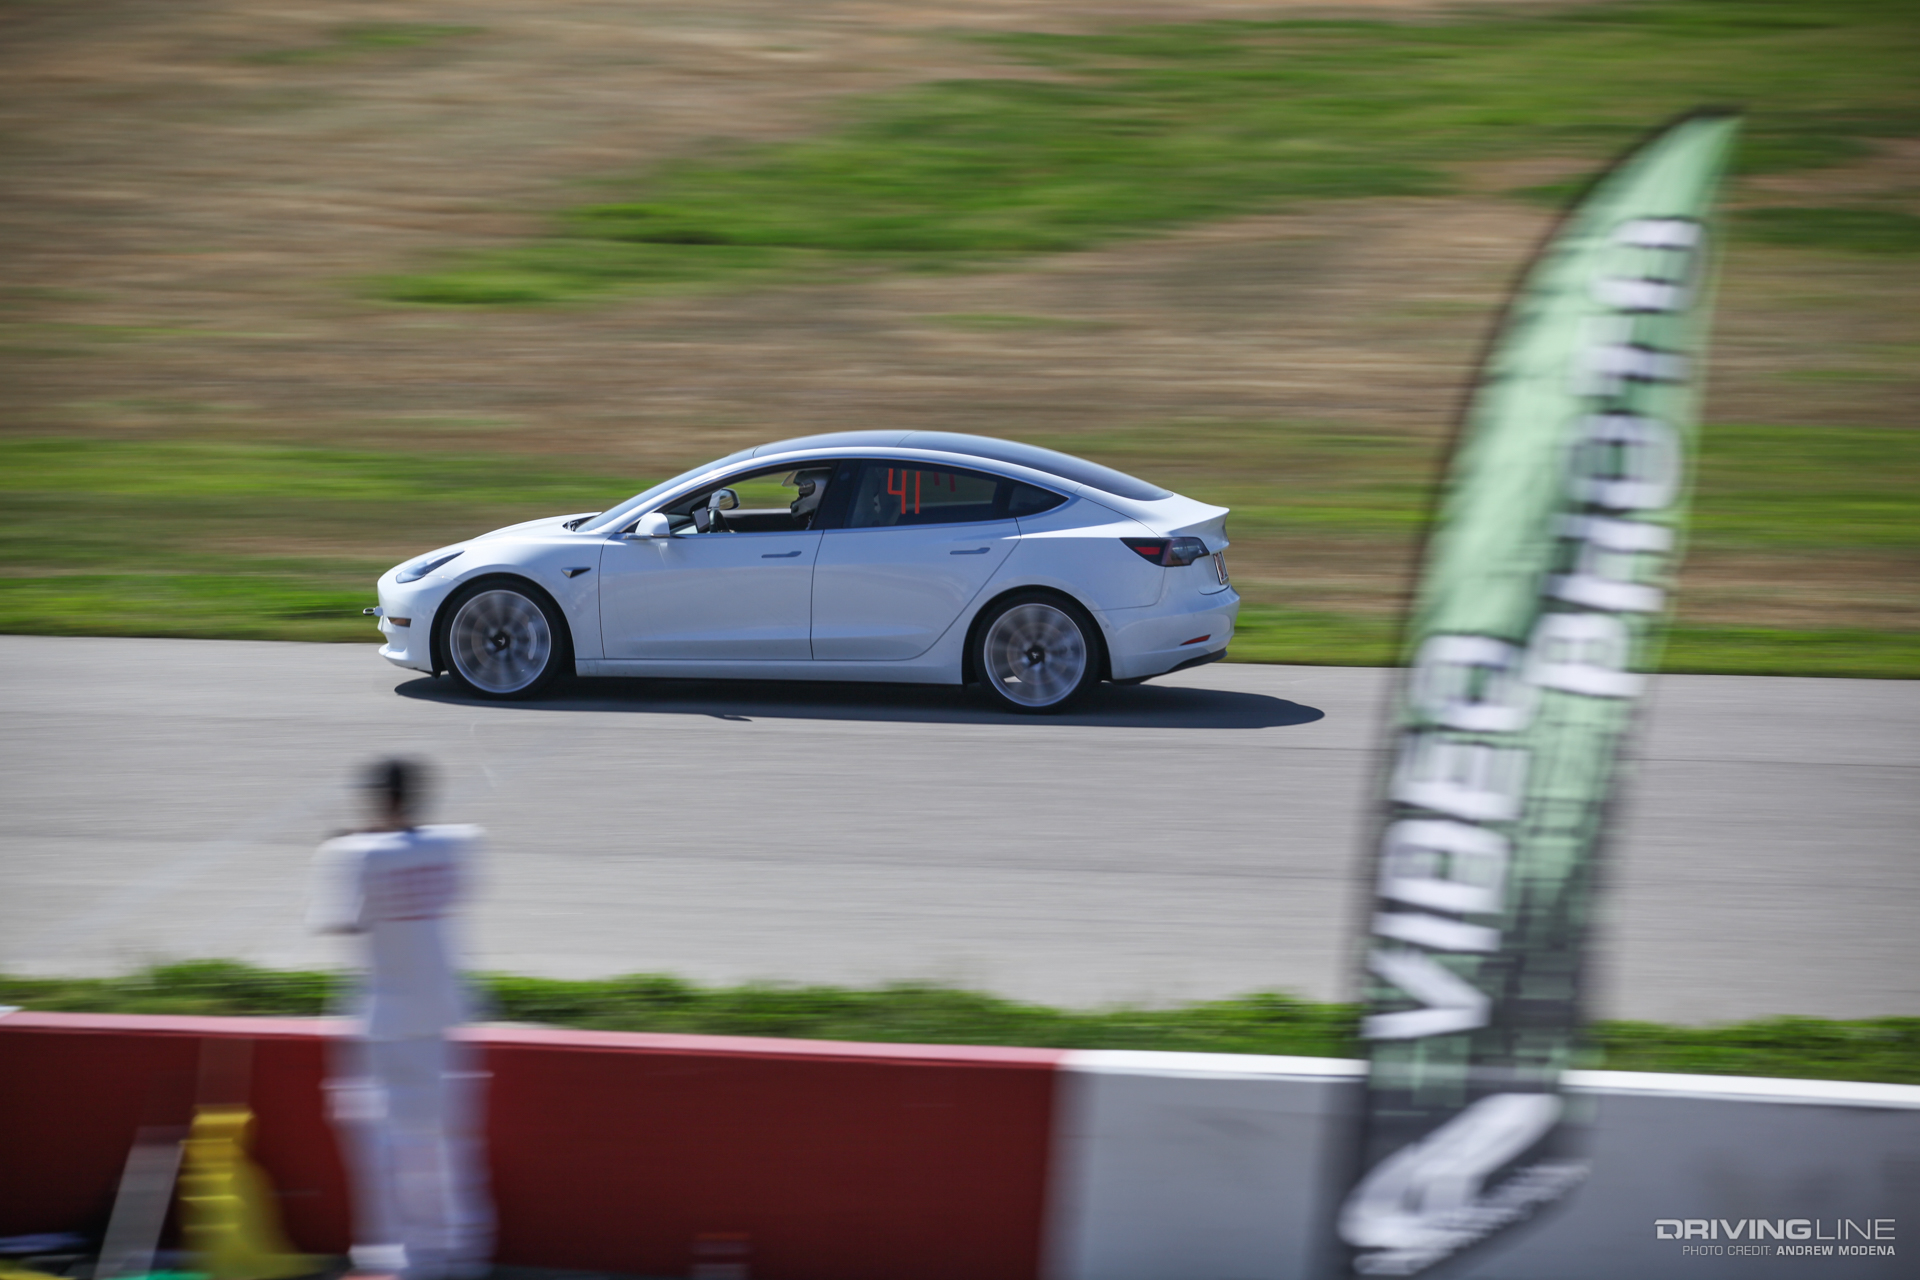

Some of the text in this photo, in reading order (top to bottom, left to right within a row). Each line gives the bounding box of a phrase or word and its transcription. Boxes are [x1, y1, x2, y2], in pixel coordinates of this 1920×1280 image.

[887, 468, 921, 514] 41
[1522, 216, 1706, 698] PHOTO
[1361, 634, 1536, 1040] VIDEO
